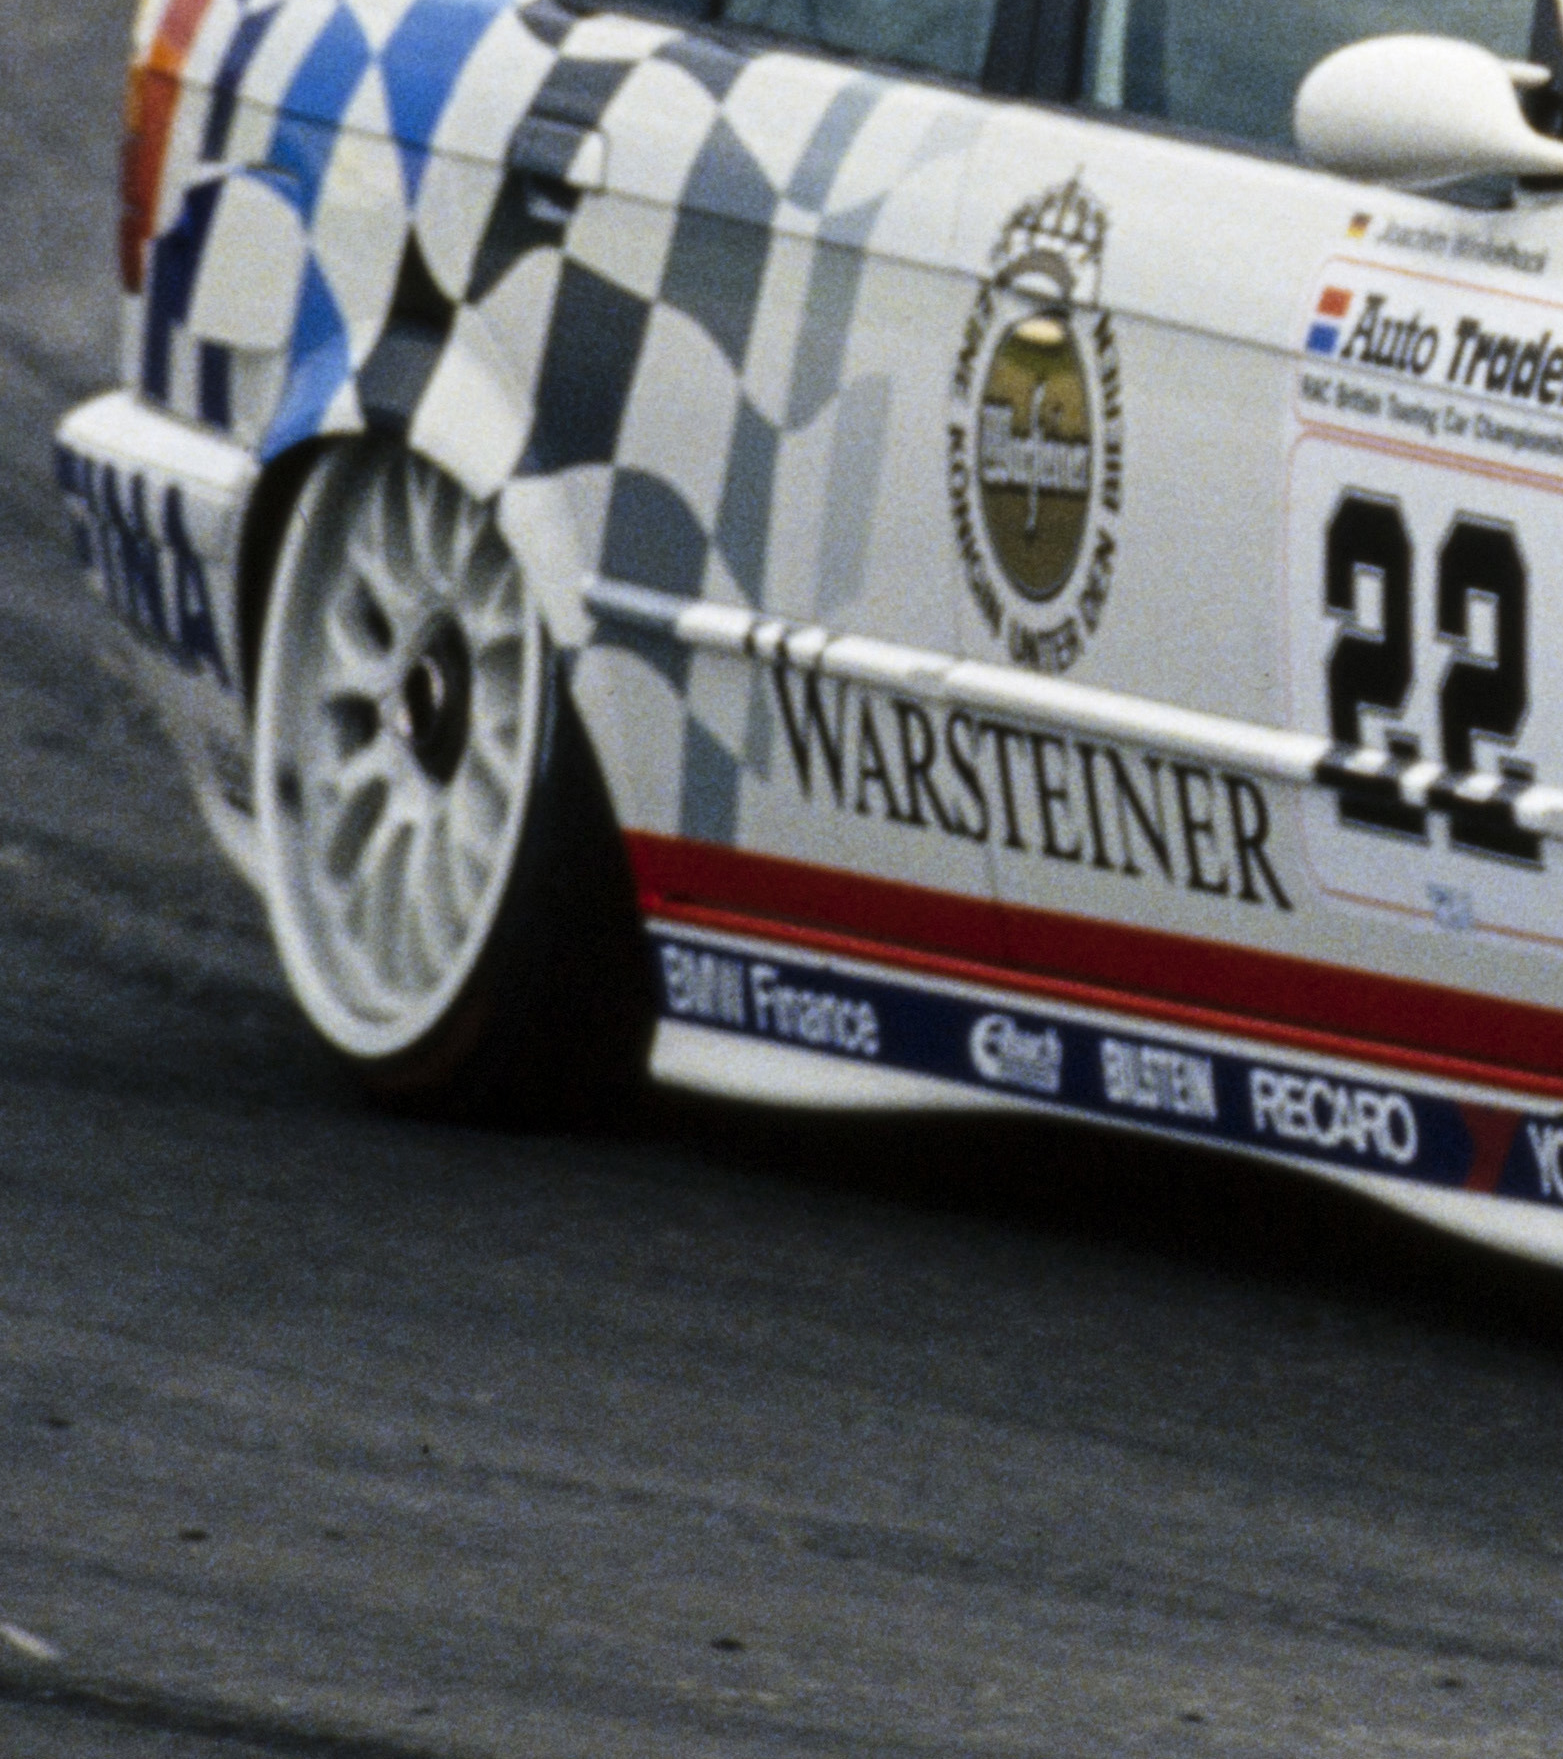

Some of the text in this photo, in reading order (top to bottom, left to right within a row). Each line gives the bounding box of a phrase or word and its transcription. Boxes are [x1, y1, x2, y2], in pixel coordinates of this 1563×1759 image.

[1340, 291, 1442, 377] Auto
[1313, 485, 1546, 872] 22
[745, 618, 1294, 913] WARSTEINER
[749, 962, 881, 1058] Finance
[1249, 1066, 1419, 1165] RECARO
